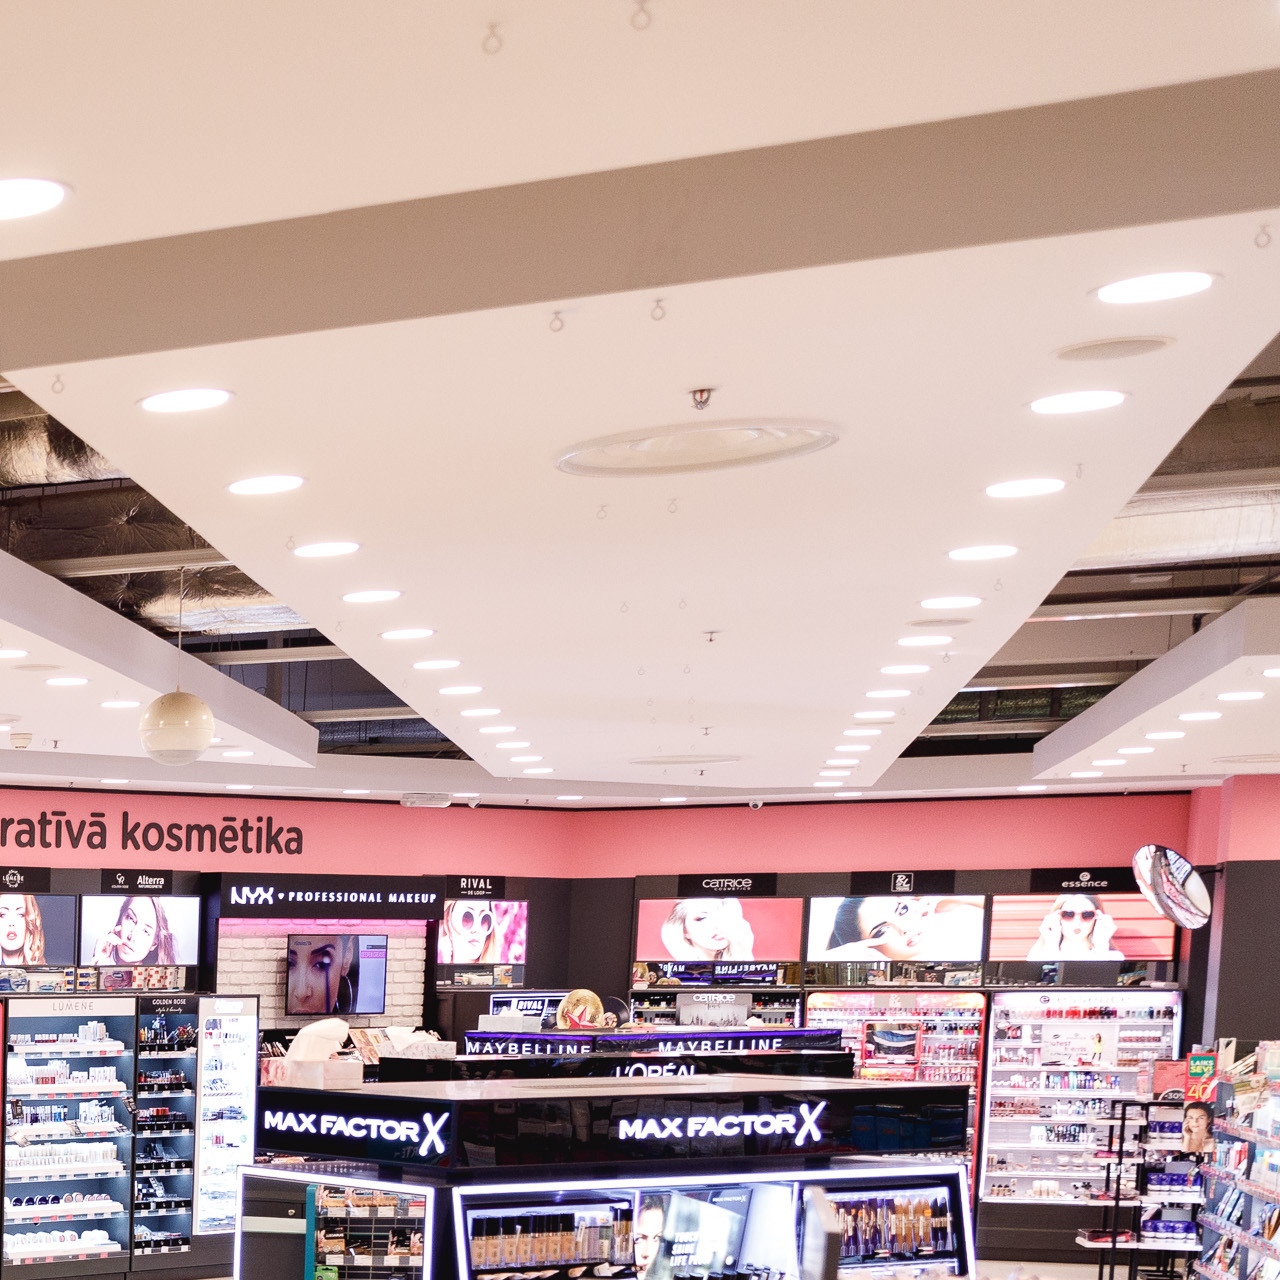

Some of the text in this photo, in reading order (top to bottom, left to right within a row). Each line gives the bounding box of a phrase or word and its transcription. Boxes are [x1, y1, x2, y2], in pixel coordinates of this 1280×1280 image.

[122, 813, 303, 855] kosmētika
[137, 875, 165, 884] Alterra
[460, 878, 492, 889] RIVAL
[1061, 880, 1109, 888] essence
[230, 886, 437, 905] NYX PROFESSIONAL MAKEUP
[517, 1000, 543, 1009] RIVAL
[466, 1040, 591, 1054] MAYBELLINE
[658, 1038, 783, 1052] MAYBELLINE
[618, 1101, 828, 1147] MAX FACTOR X
[264, 1110, 450, 1156] MAX FACTOR X
[670, 1255, 687, 1266] LIFE
